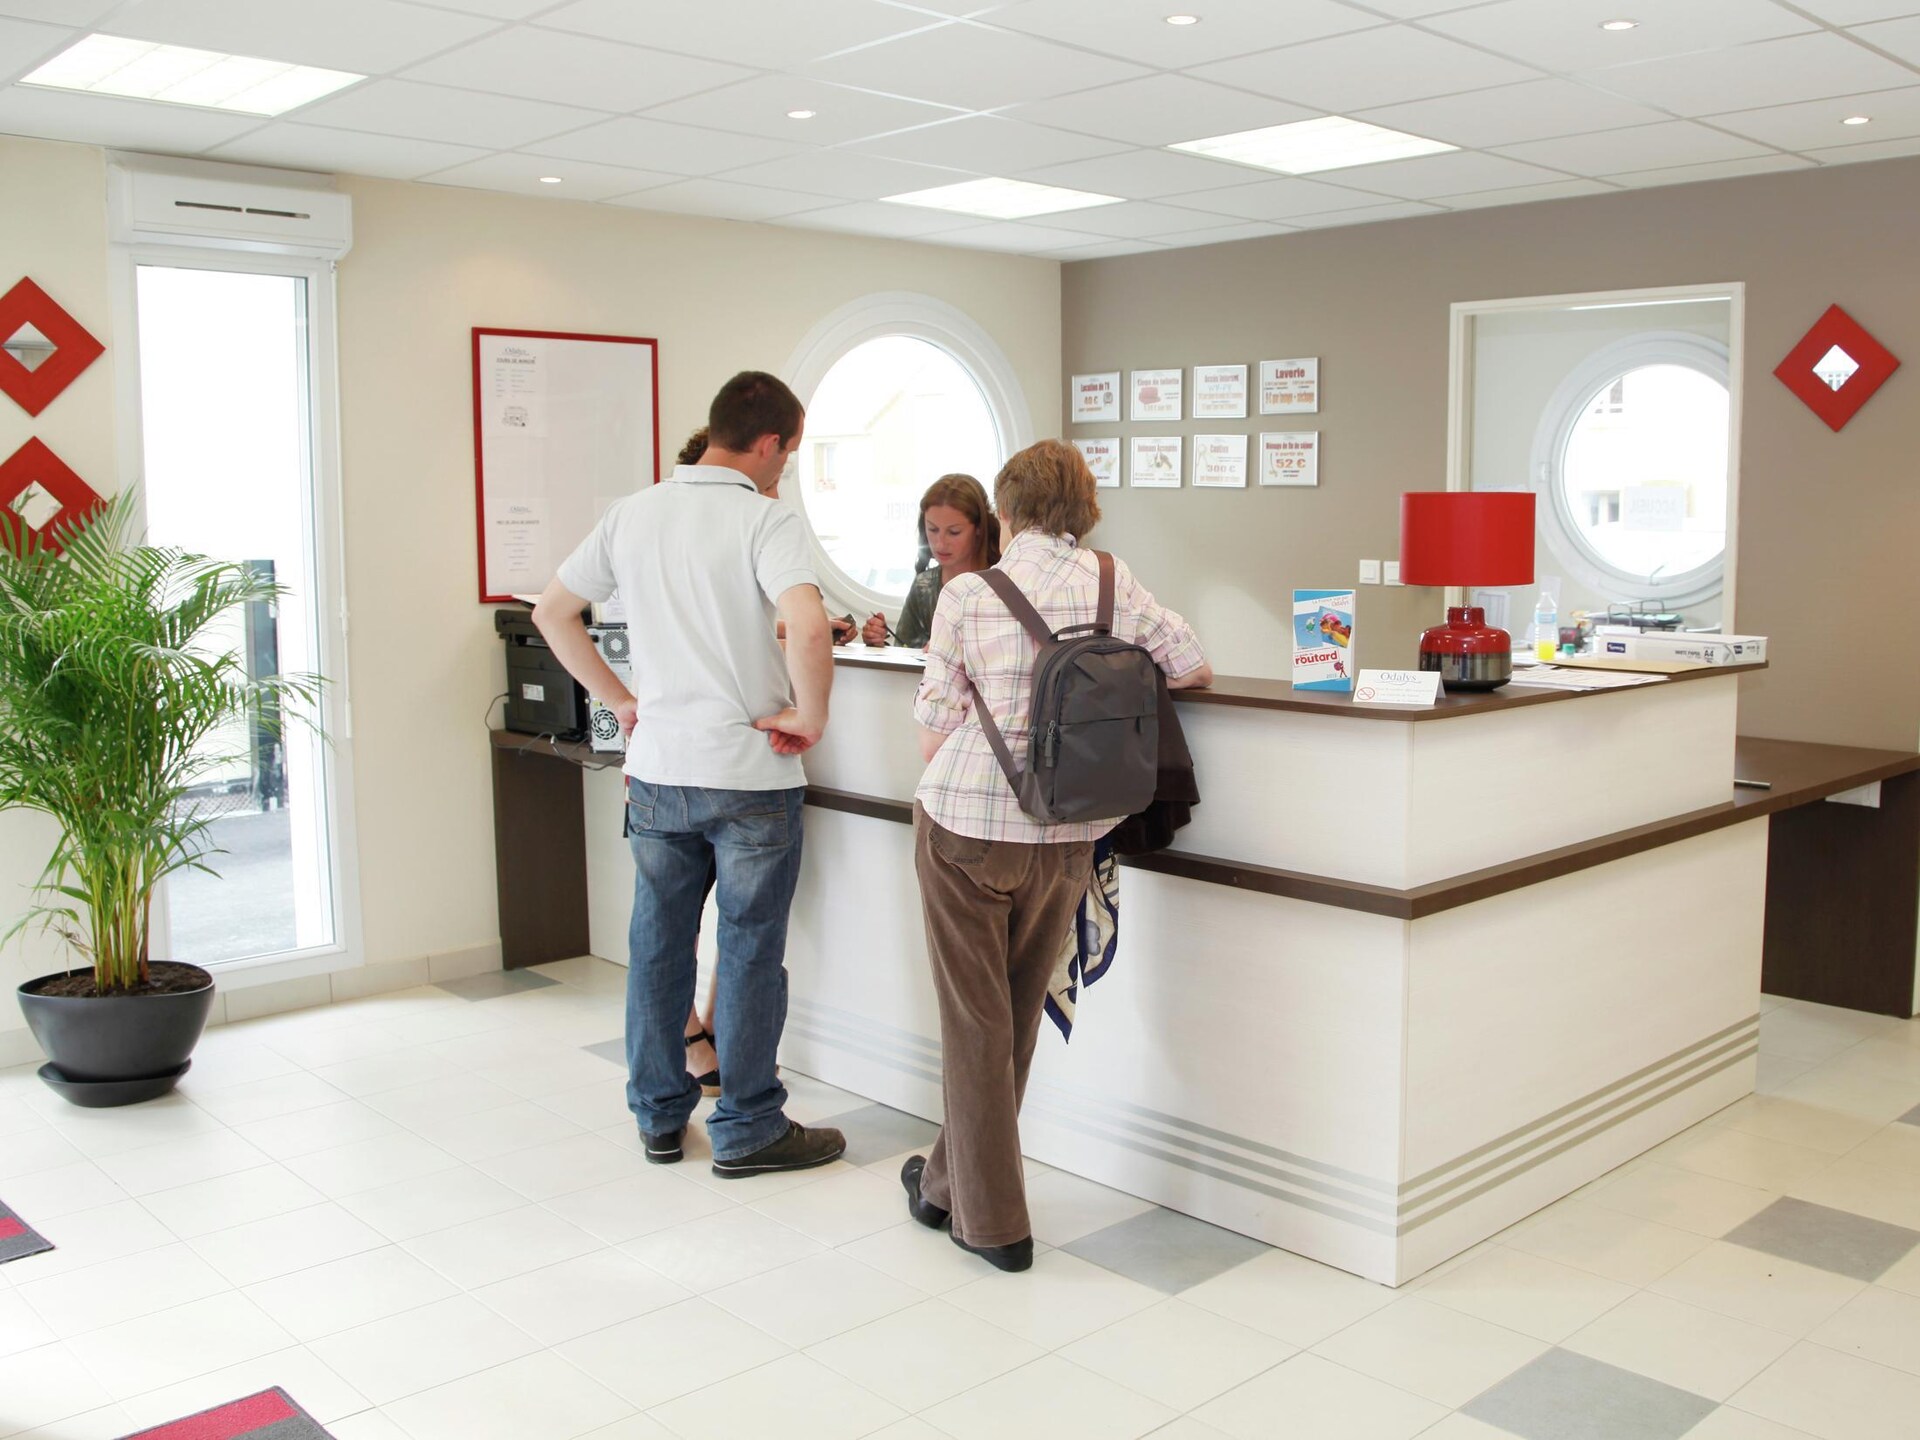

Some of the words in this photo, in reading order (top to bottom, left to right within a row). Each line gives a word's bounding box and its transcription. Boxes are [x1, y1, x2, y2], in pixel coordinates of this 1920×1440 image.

[1275, 368, 1305, 379] Laverie
[1276, 458, 1295, 469] 52
[1297, 458, 1306, 469] €
[1295, 651, 1338, 665] routard
[1704, 649, 1714, 657] A4
[1380, 672, 1417, 681] Odalys
